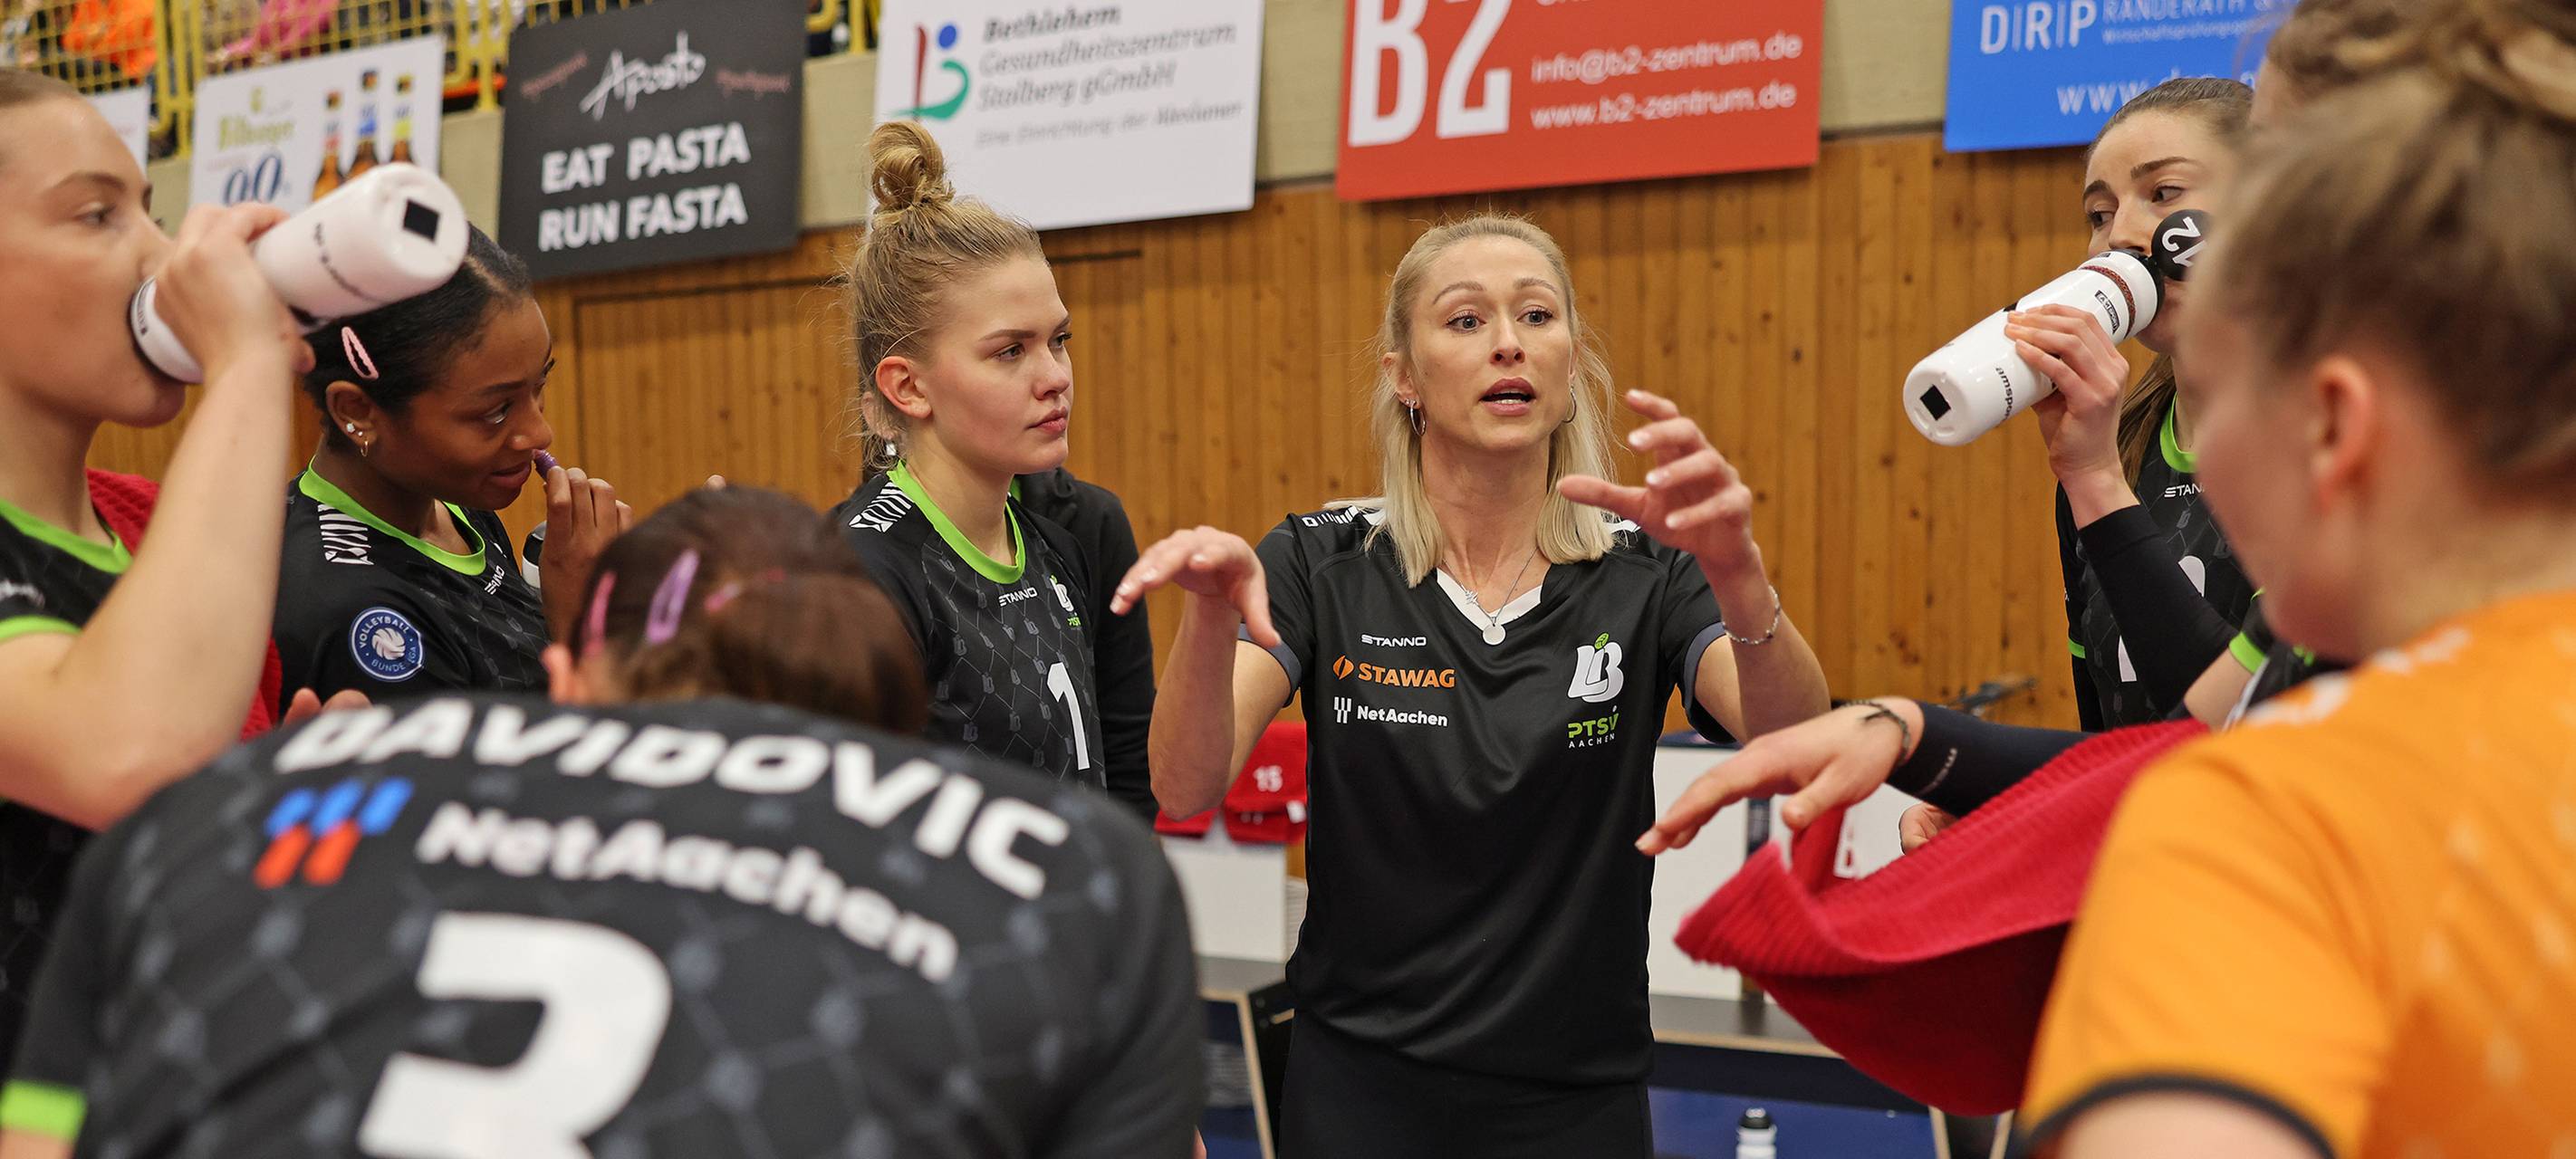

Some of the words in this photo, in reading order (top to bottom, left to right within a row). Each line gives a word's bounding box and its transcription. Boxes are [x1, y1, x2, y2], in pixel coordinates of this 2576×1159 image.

[982, 5, 1122, 43] Bethlehem
[977, 23, 1237, 79] Gesundheitszentrum
[1348, 0, 1512, 146] B2
[1531, 31, 1804, 84] info@b2-zentrum.de
[976, 78, 1077, 110] Stolberg
[1531, 80, 1798, 129] www.b2-zentrum.de
[541, 142, 615, 194] EAT
[627, 121, 751, 180] PASTA
[538, 199, 621, 252] RUN
[626, 182, 748, 239] FASTA
[359, 616, 409, 648] VOLLEYBALL
[1361, 635, 1427, 647] STANNO
[1358, 663, 1456, 688] STAWAG
[1047, 662, 1090, 771] 1
[1357, 705, 1448, 726] NetAachen
[1569, 733, 1615, 749] AACHEN
[273, 698, 1071, 900] DAVIDOVIC
[1253, 765, 1283, 792] 15
[415, 800, 961, 985] NetAachen
[357, 911, 673, 1159] 3
